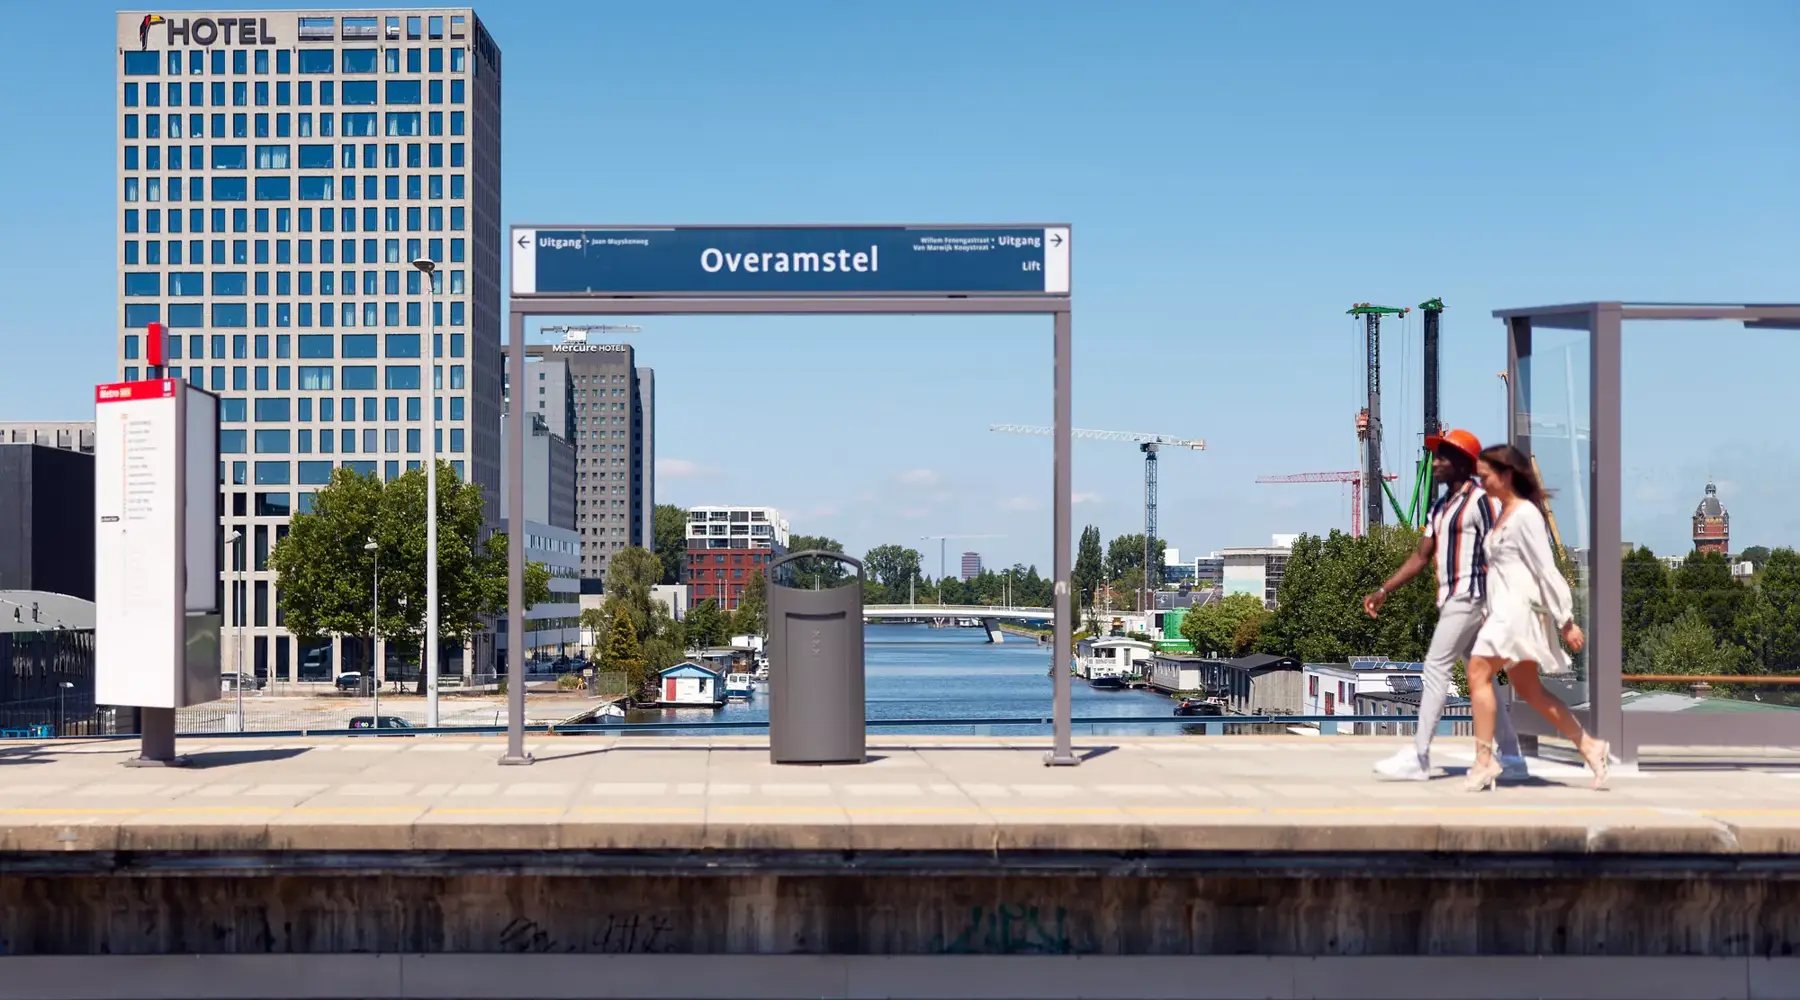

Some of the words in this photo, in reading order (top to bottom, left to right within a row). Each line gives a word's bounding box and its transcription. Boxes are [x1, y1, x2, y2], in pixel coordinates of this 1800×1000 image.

[167, 17, 276, 46] HOTEL
[539, 237, 582, 250] Uitgang
[998, 235, 1041, 248] Uitgang
[700, 244, 878, 273] Overamstel
[1022, 260, 1041, 271] Lift
[552, 344, 597, 352] Mercure
[598, 344, 626, 352] HOTEL
